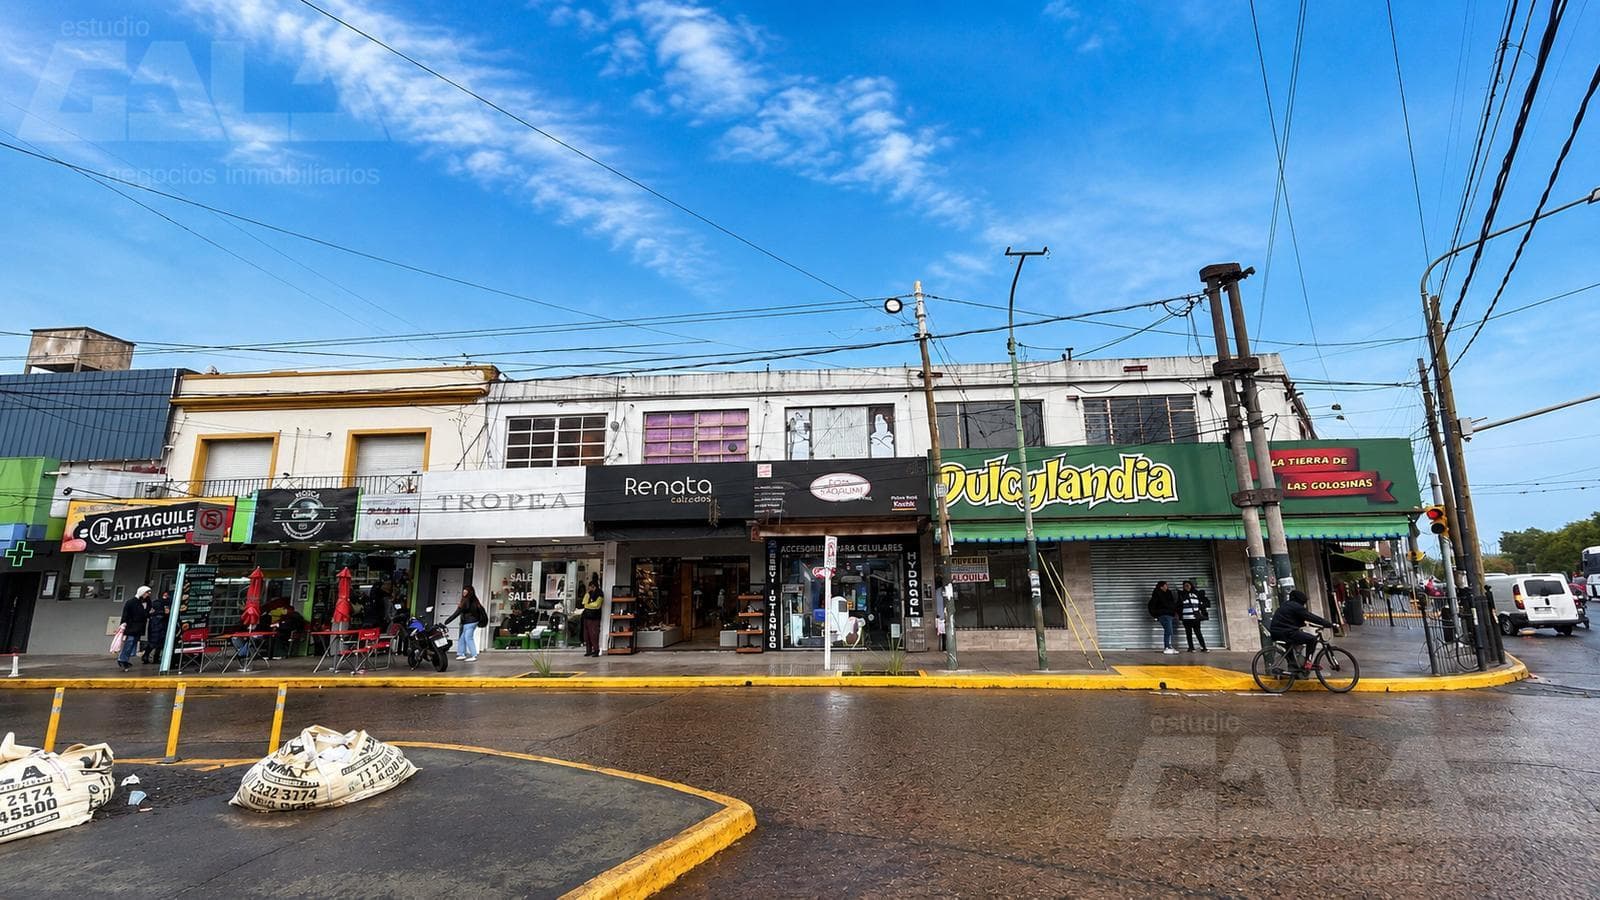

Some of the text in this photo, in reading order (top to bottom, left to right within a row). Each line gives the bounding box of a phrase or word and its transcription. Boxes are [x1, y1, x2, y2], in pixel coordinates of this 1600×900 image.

[1288, 457, 1329, 466] TIERRA
[1333, 456, 1348, 465] DE
[625, 476, 712, 496] Renata
[936, 453, 1178, 512] Dulcylandia
[1287, 478, 1373, 490] LAS GOLOSINAS
[437, 492, 569, 511] TROPEA
[857, 543, 903, 552] CELULARES
[510, 573, 533, 582] SALE
[508, 592, 534, 601] SALE
